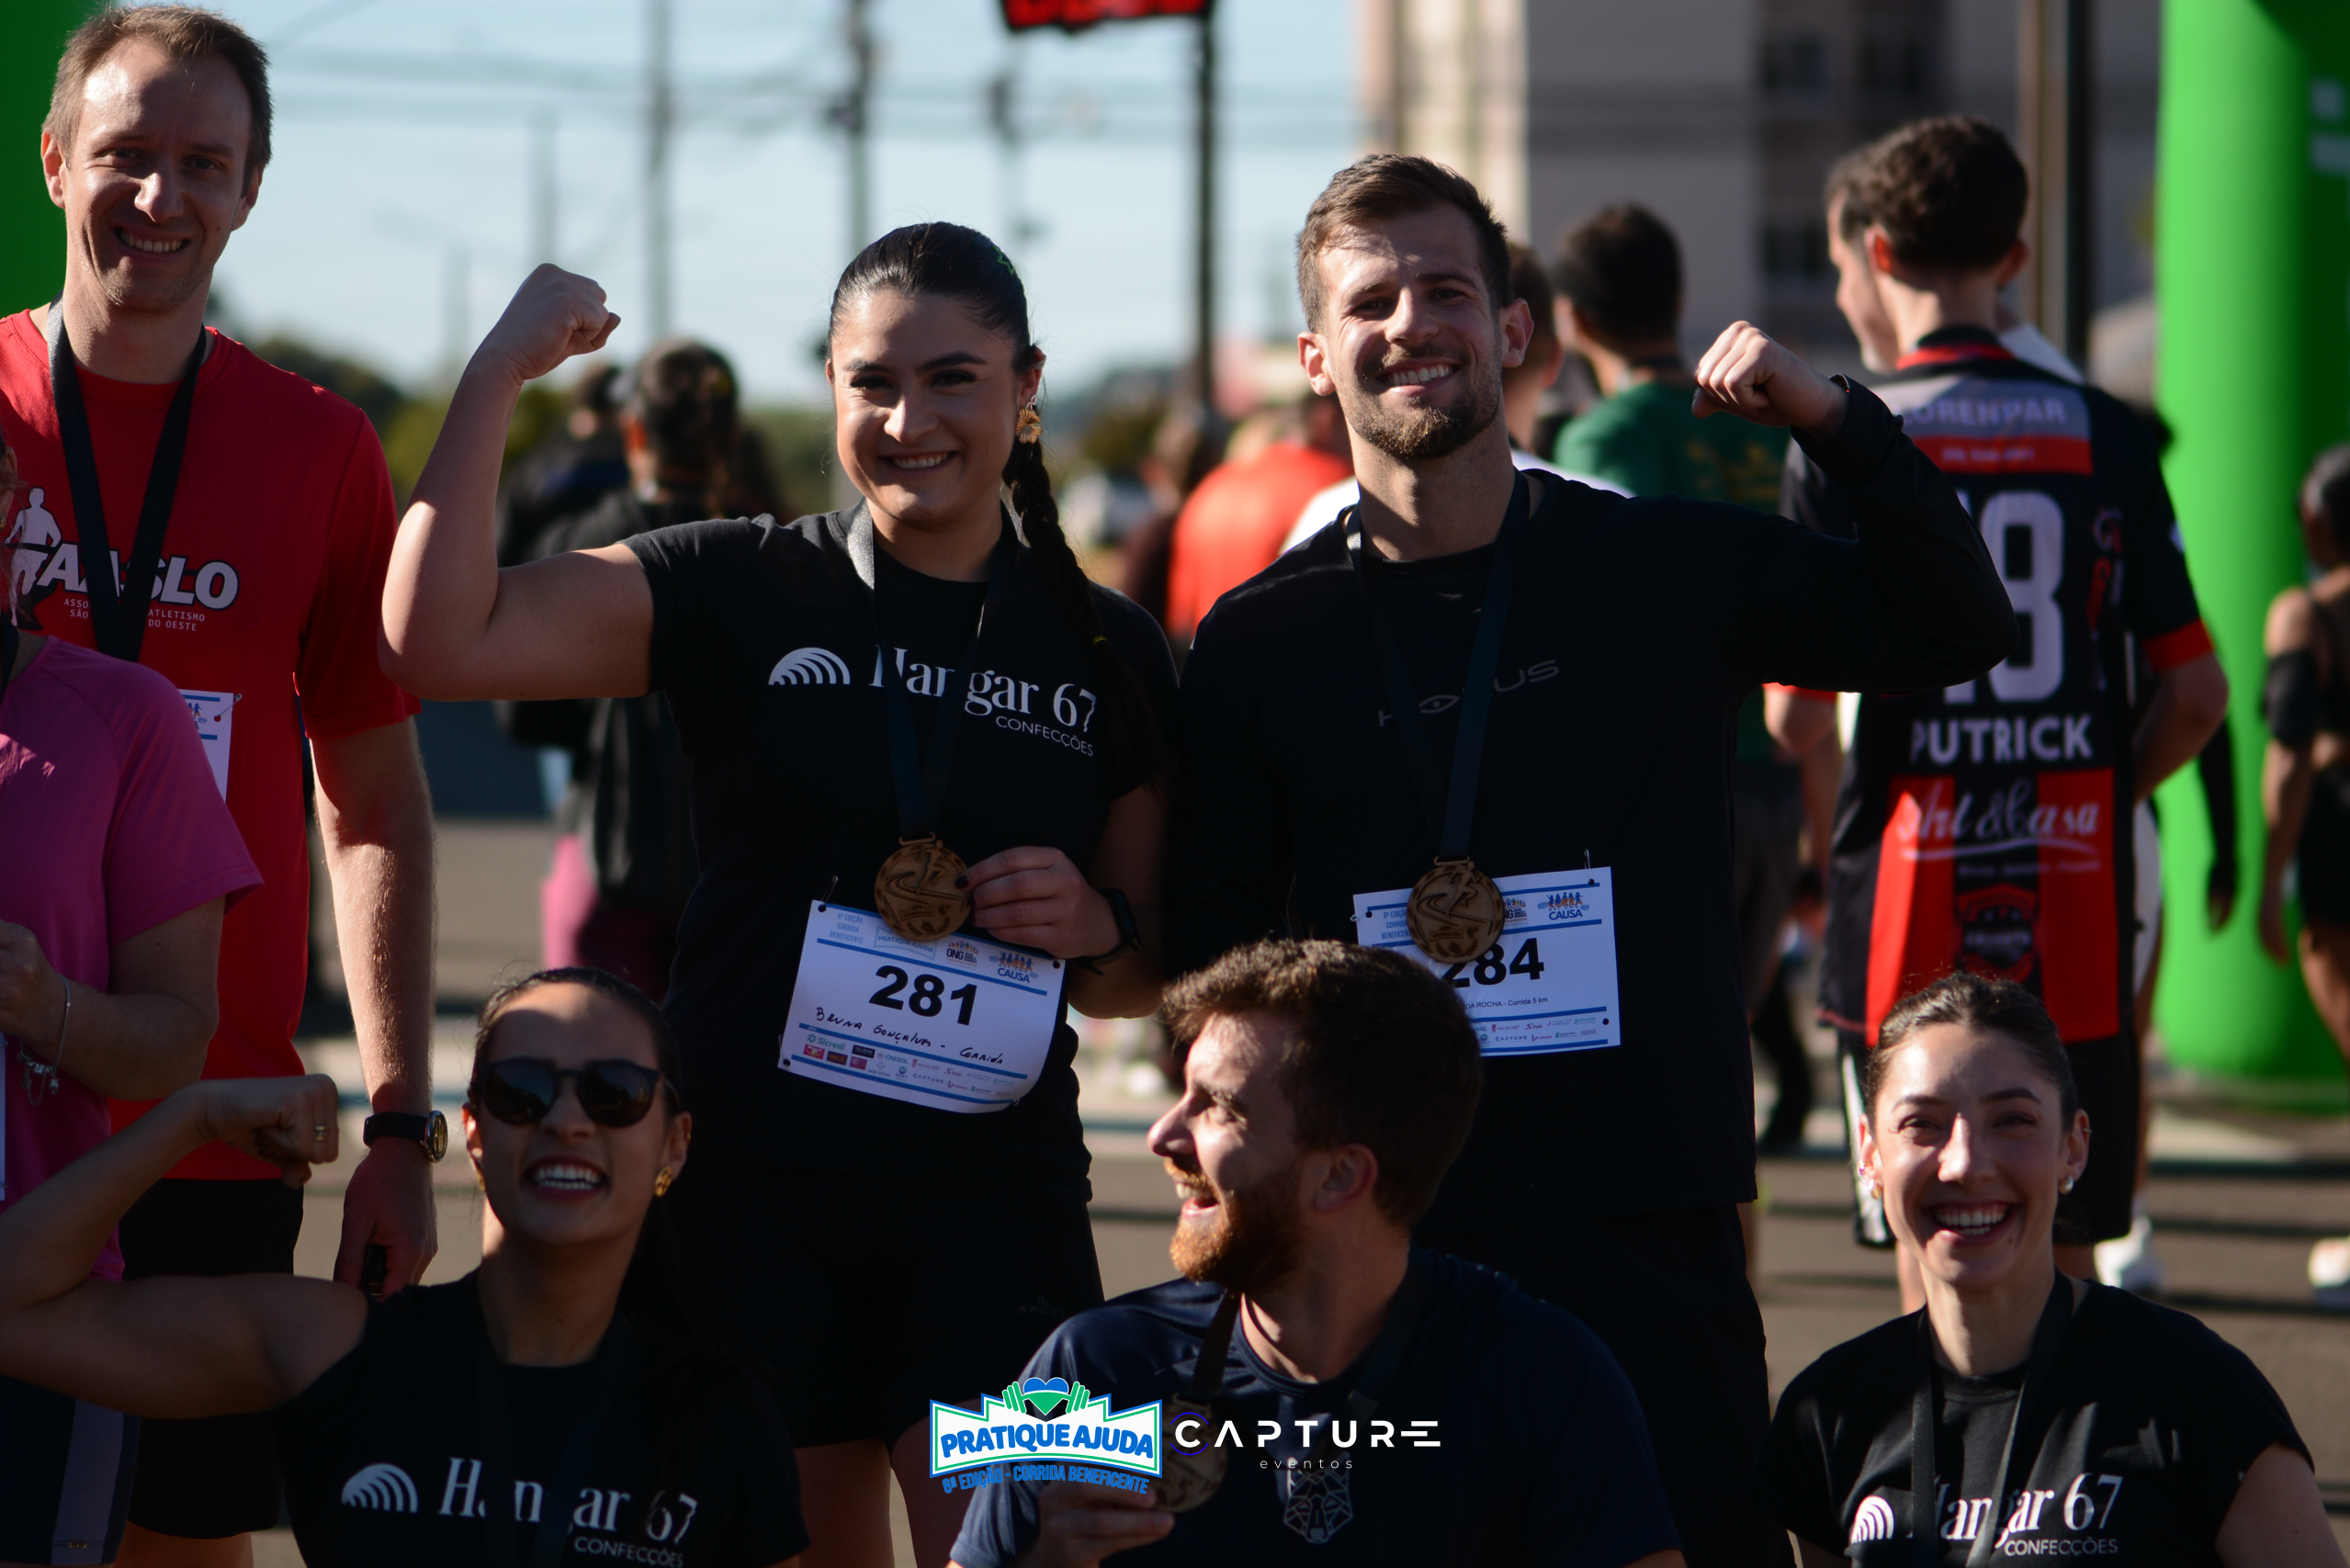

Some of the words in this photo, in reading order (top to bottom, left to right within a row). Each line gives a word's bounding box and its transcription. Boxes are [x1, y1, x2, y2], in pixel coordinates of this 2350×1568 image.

[69, 608, 89, 619] SÃO
[148, 618, 162, 628] DO
[165, 620, 198, 632] OESTE
[148, 609, 206, 622] ATLETISMO
[1052, 682, 1098, 733] 67
[995, 715, 1094, 757] CONFECÇÕES
[845, 913, 864, 924] EDIÇÃO
[1549, 908, 1583, 920] CAUSA
[837, 922, 860, 933] CORRIDA
[830, 931, 864, 944] BENEFICENTE
[946, 948, 965, 961] ONG
[998, 967, 1031, 984] CAUSA
[868, 964, 977, 1026] 281
[1476, 1000, 1502, 1009] ROCHA
[1508, 998, 1531, 1007] Corrida
[818, 1037, 846, 1051] Sicredi
[885, 1055, 909, 1065] CRESOL
[1019, 1305, 1068, 1317] SPORT
[436, 1456, 632, 1535] Hnar
[643, 1487, 699, 1546] 67
[2063, 1472, 2124, 1530] 67
[573, 1535, 684, 1568] CONFECÇÕES
[2004, 1535, 2119, 1557] CONFECÇÕES
